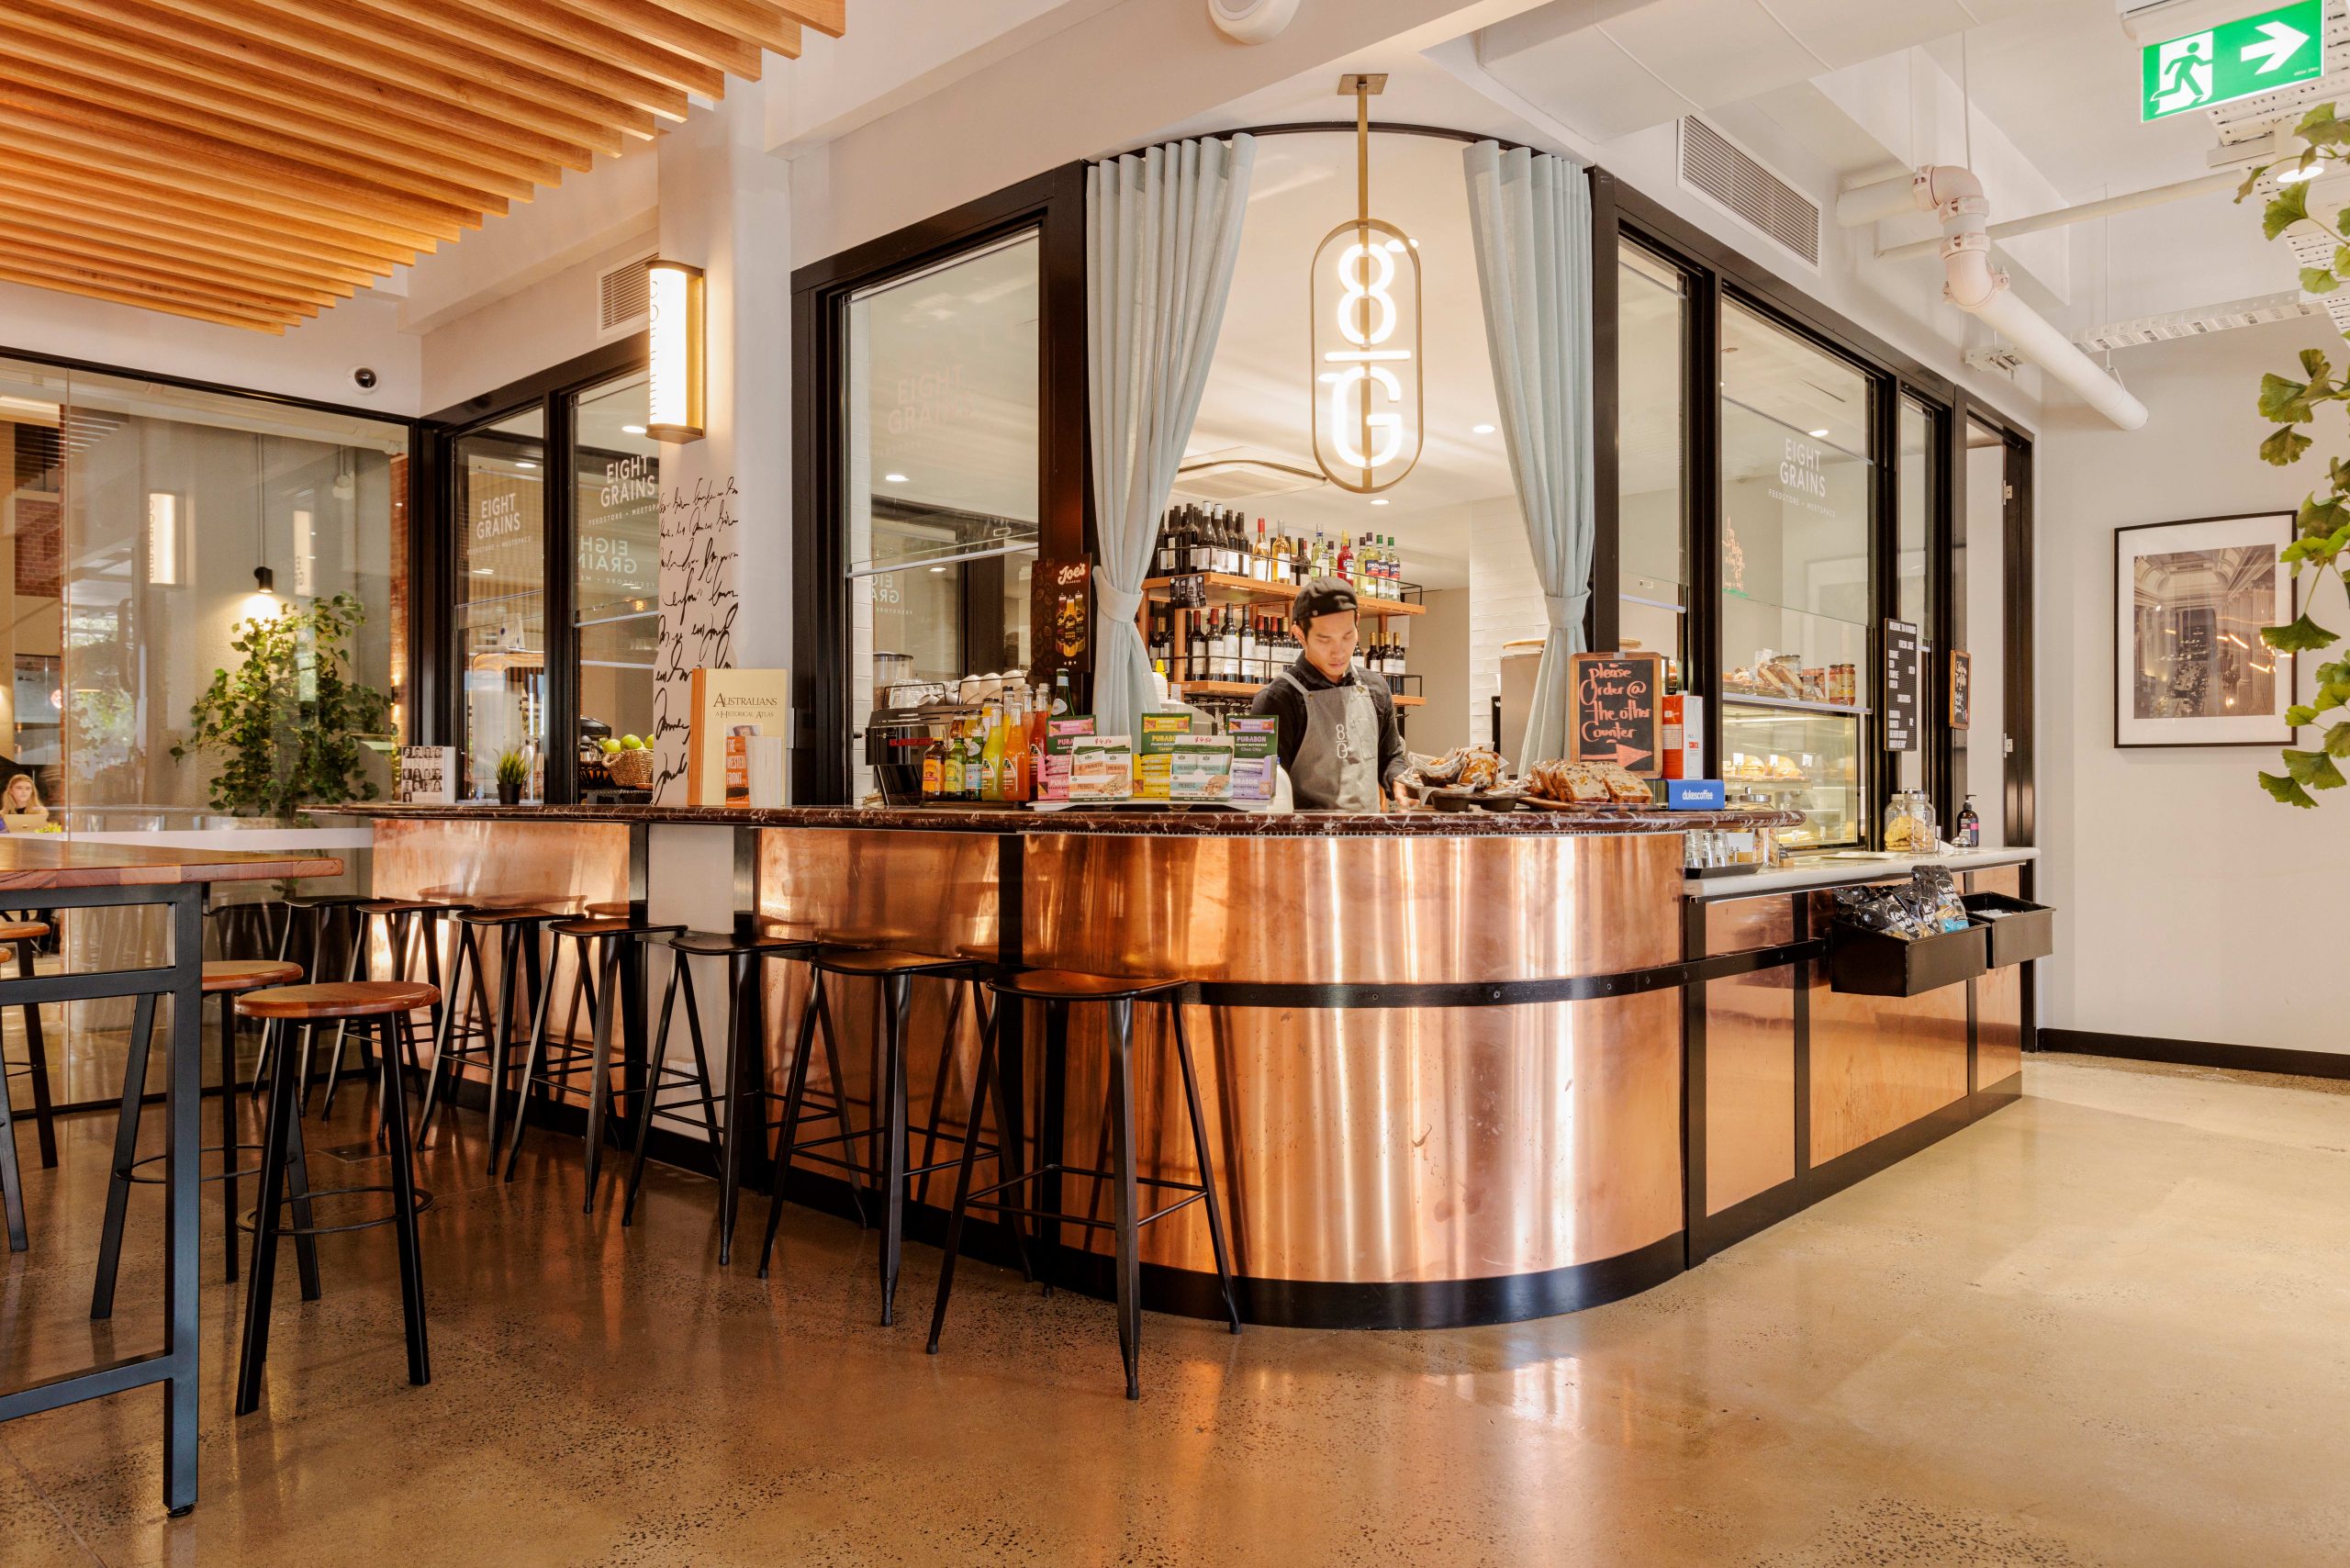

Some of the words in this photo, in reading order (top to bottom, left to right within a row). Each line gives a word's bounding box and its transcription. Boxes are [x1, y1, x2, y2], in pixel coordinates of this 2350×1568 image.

[1337, 243, 1395, 345] 8
[1332, 365, 1402, 468] G
[1785, 438, 1821, 471] EIGHT
[607, 454, 650, 484] EIGHT
[1780, 462, 1826, 498] GRAINS
[600, 475, 655, 507] GRAINS
[481, 493, 516, 519] EIGHT
[588, 511, 622, 526] FEEDSTORE
[476, 512, 520, 539] GRAINS
[1058, 562, 1086, 586] Joe's
[713, 692, 778, 708] AUSTRALIANS
[1626, 680, 1647, 699] @
[720, 711, 754, 719] HISTORICAL
[755, 711, 775, 719] ATLAS
[406, 758, 440, 767] UNITE
[1682, 789, 1714, 801] dukescoffee
